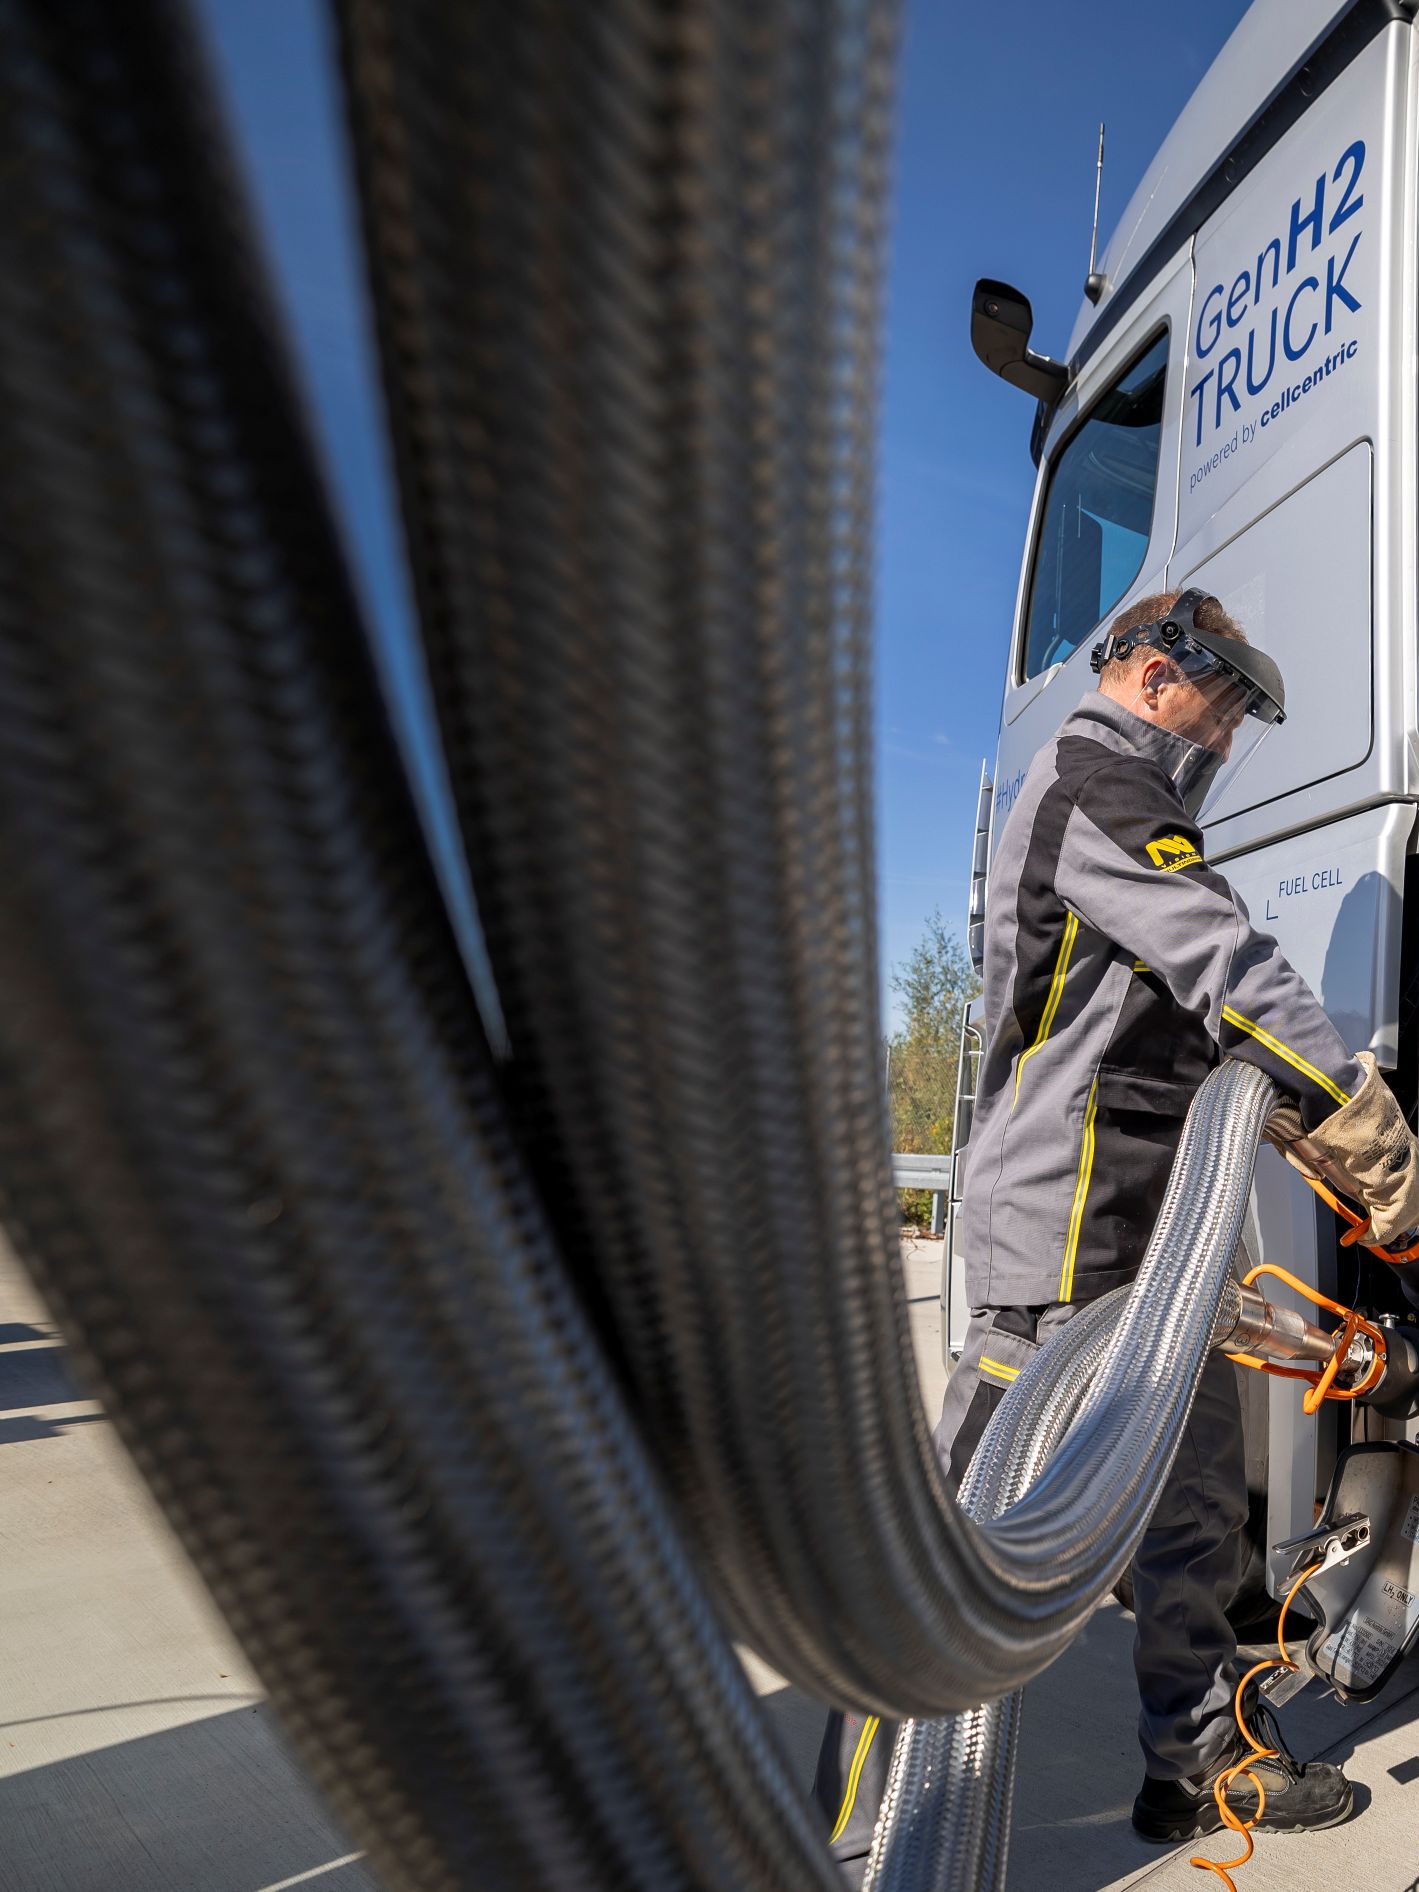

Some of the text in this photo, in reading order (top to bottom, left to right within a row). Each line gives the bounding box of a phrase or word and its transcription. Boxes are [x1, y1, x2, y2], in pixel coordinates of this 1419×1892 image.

[1195, 139, 1366, 359] GenH2
[1190, 230, 1363, 448] TRUCK
[1190, 339, 1358, 494] powered by cellcentric
[995, 769, 1029, 815] #Hydr
[1278, 867, 1343, 898] FUEL CELL
[1396, 1590, 1414, 1605] ONLY
